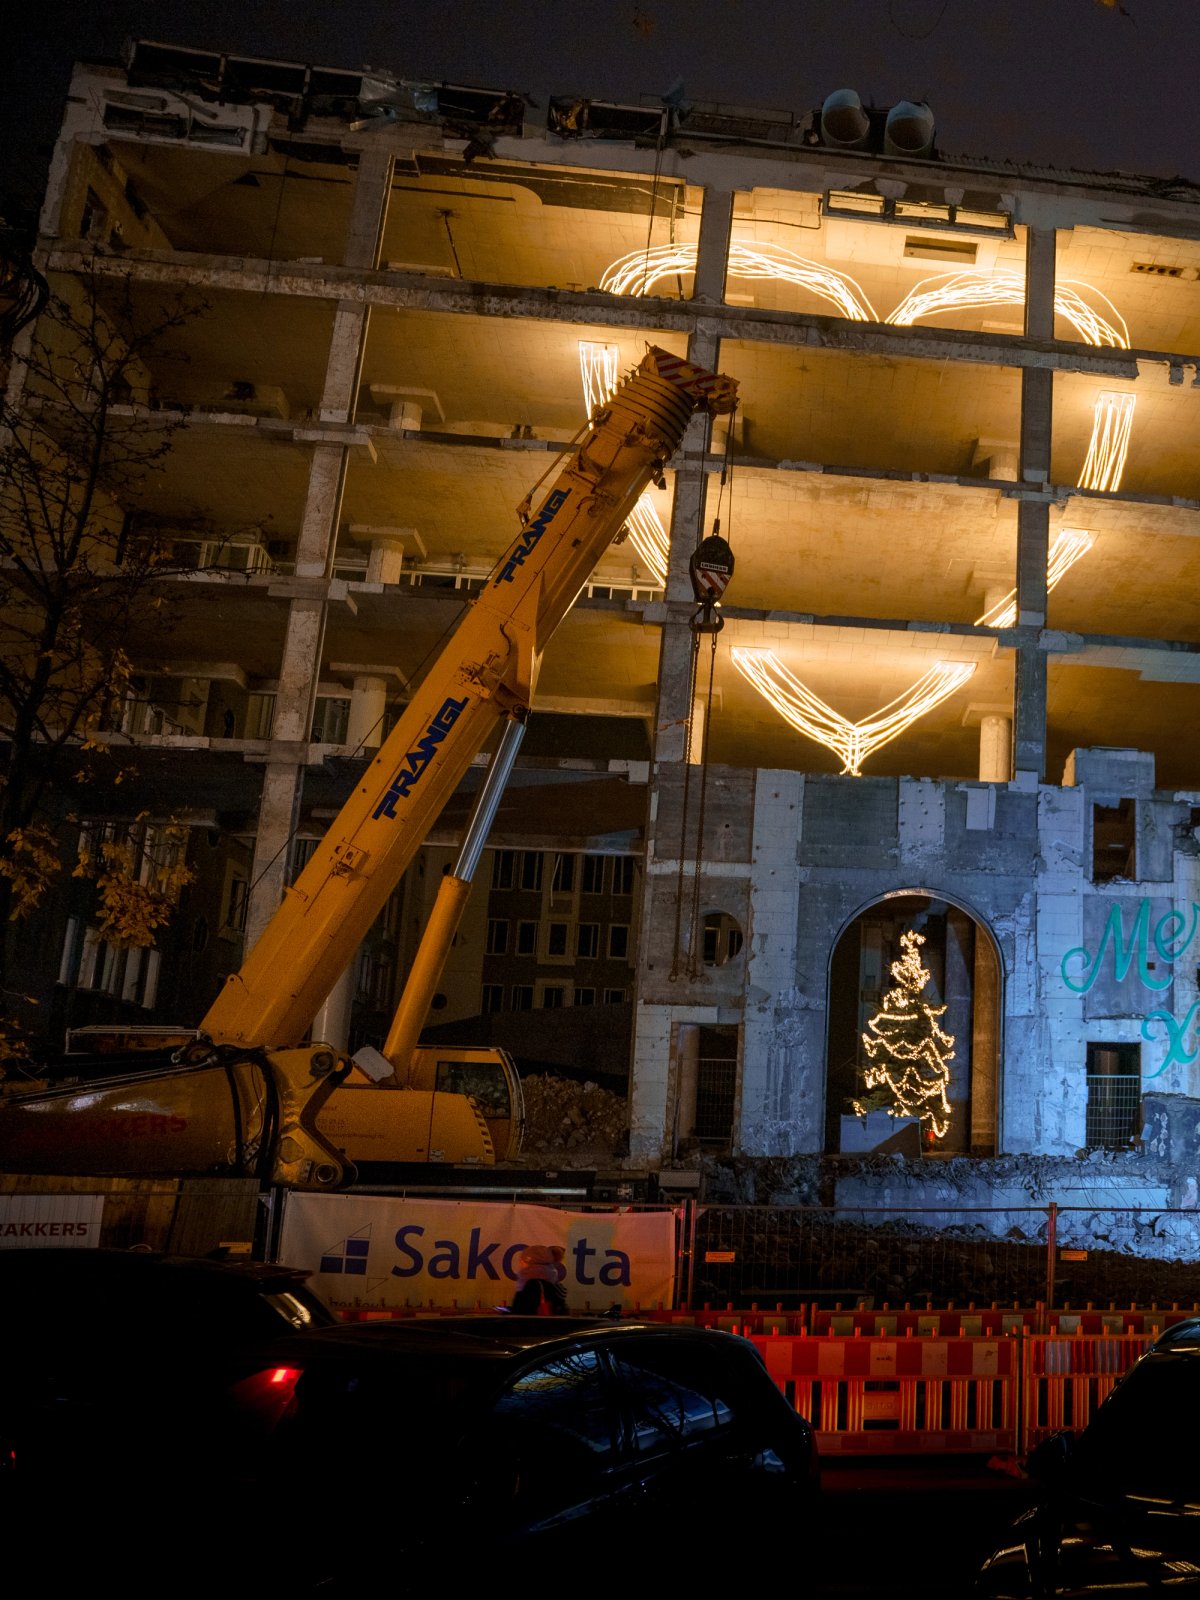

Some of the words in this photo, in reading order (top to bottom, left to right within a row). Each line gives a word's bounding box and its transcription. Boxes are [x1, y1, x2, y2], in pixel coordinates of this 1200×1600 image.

[495, 488, 572, 583] PRANGL
[372, 697, 469, 820] PRANGL
[0, 1223, 88, 1236] AKKERS
[391, 1225, 632, 1287] Sakota
